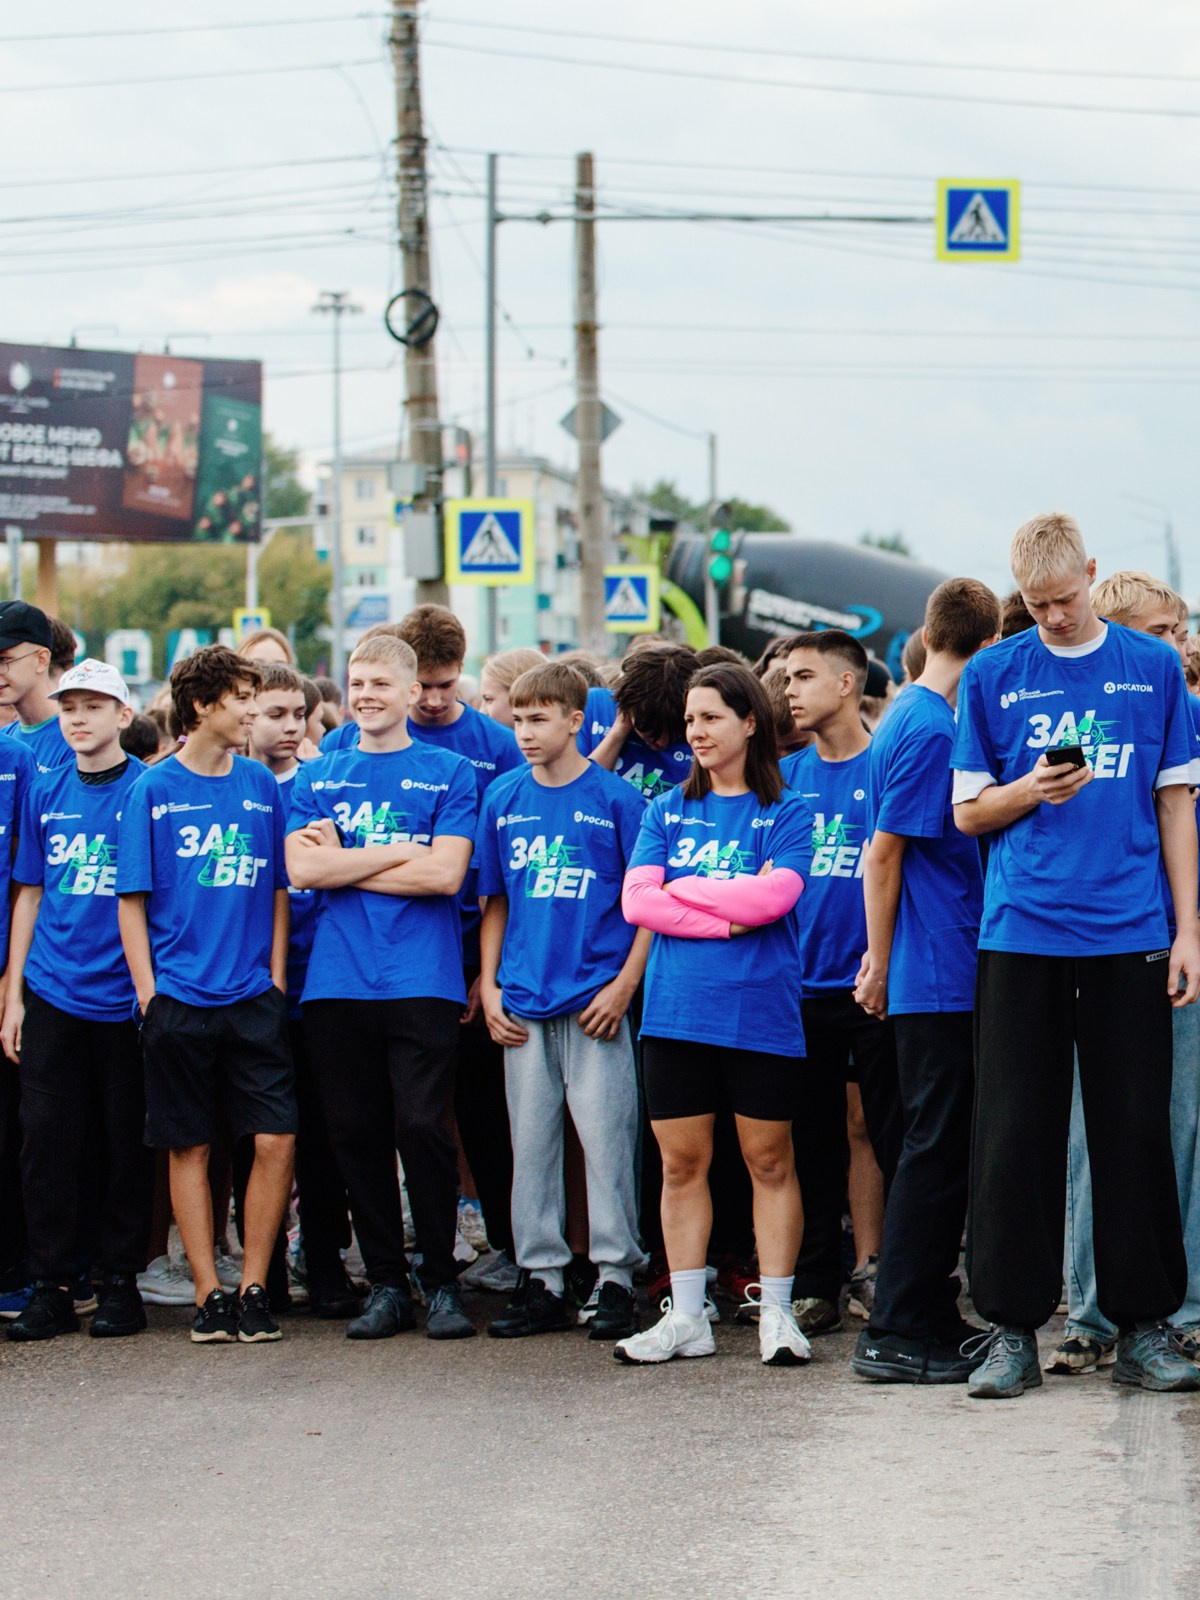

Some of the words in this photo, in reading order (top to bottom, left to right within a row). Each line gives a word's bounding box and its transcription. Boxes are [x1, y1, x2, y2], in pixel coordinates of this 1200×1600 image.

[1026, 709, 1096, 749] ЗА!
[333, 801, 392, 833] ЗА!
[47, 833, 106, 866] ЗА!
[176, 823, 239, 858] ЗА!
[509, 835, 564, 870] ЗА!
[668, 837, 740, 869] ЗА!
[72, 865, 118, 897] БЕ
[213, 855, 268, 888] БЕГ
[532, 866, 597, 900] БЕГ
